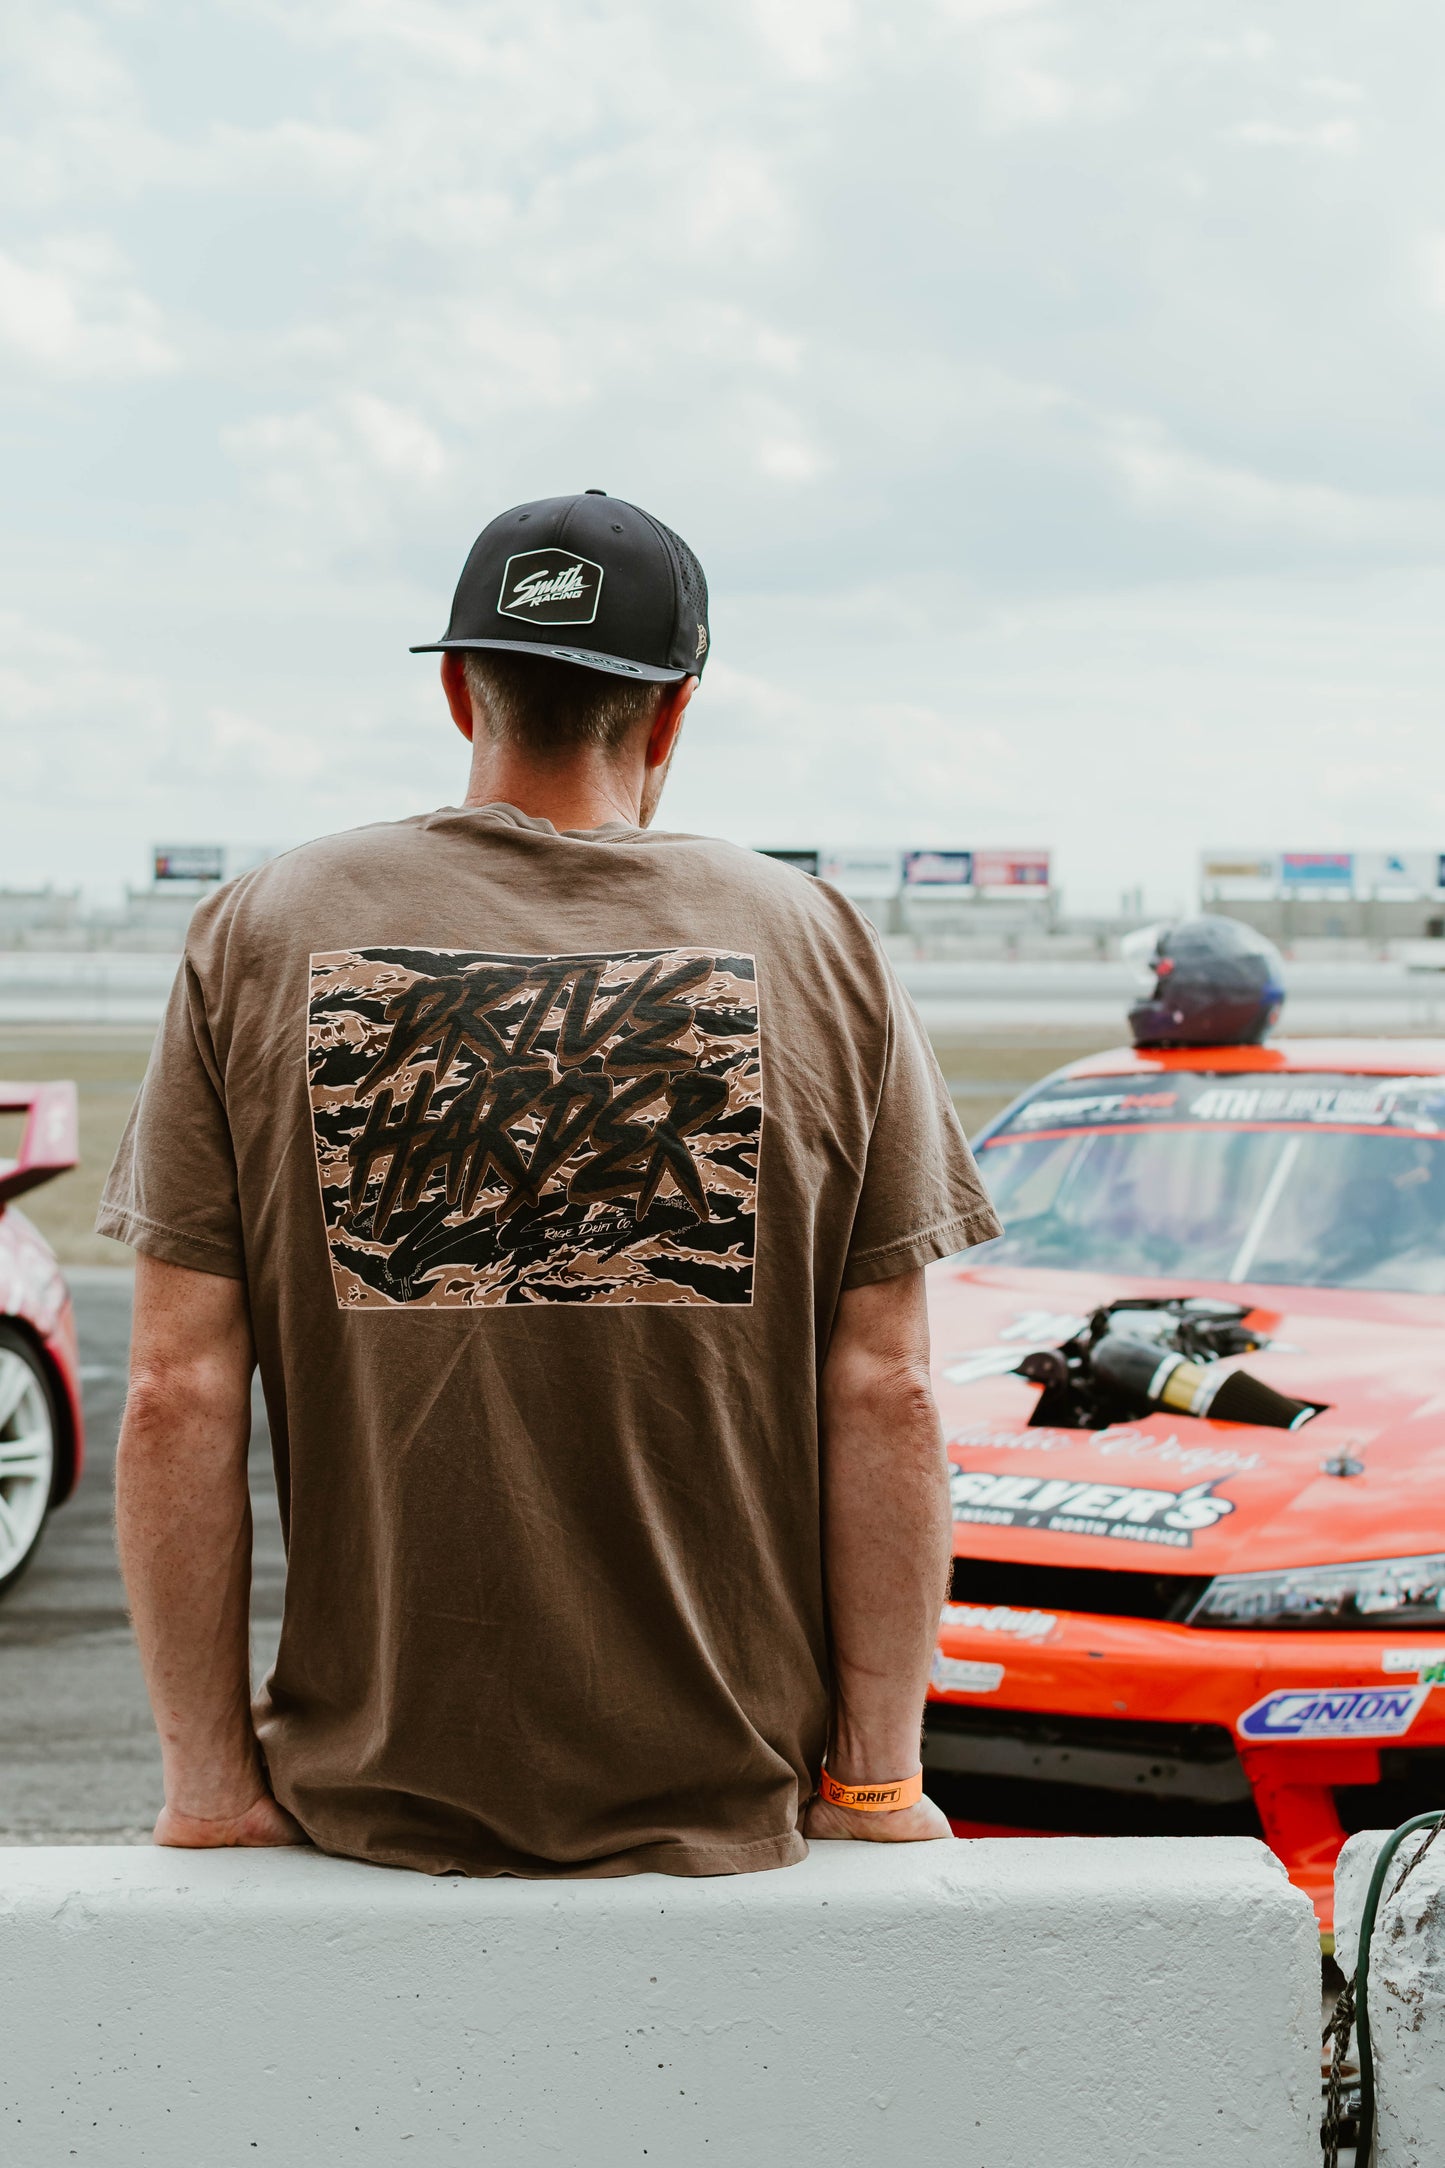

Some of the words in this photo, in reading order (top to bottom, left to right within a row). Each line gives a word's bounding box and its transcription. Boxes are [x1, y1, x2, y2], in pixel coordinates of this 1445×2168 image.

[505, 563, 592, 609] Smith
[529, 590, 583, 607] RACING
[354, 957, 716, 1102] DRIVE
[348, 1068, 731, 1240] HARDER
[1050, 1515, 1109, 1536] NORTH
[1110, 1523, 1189, 1546] AMERICA
